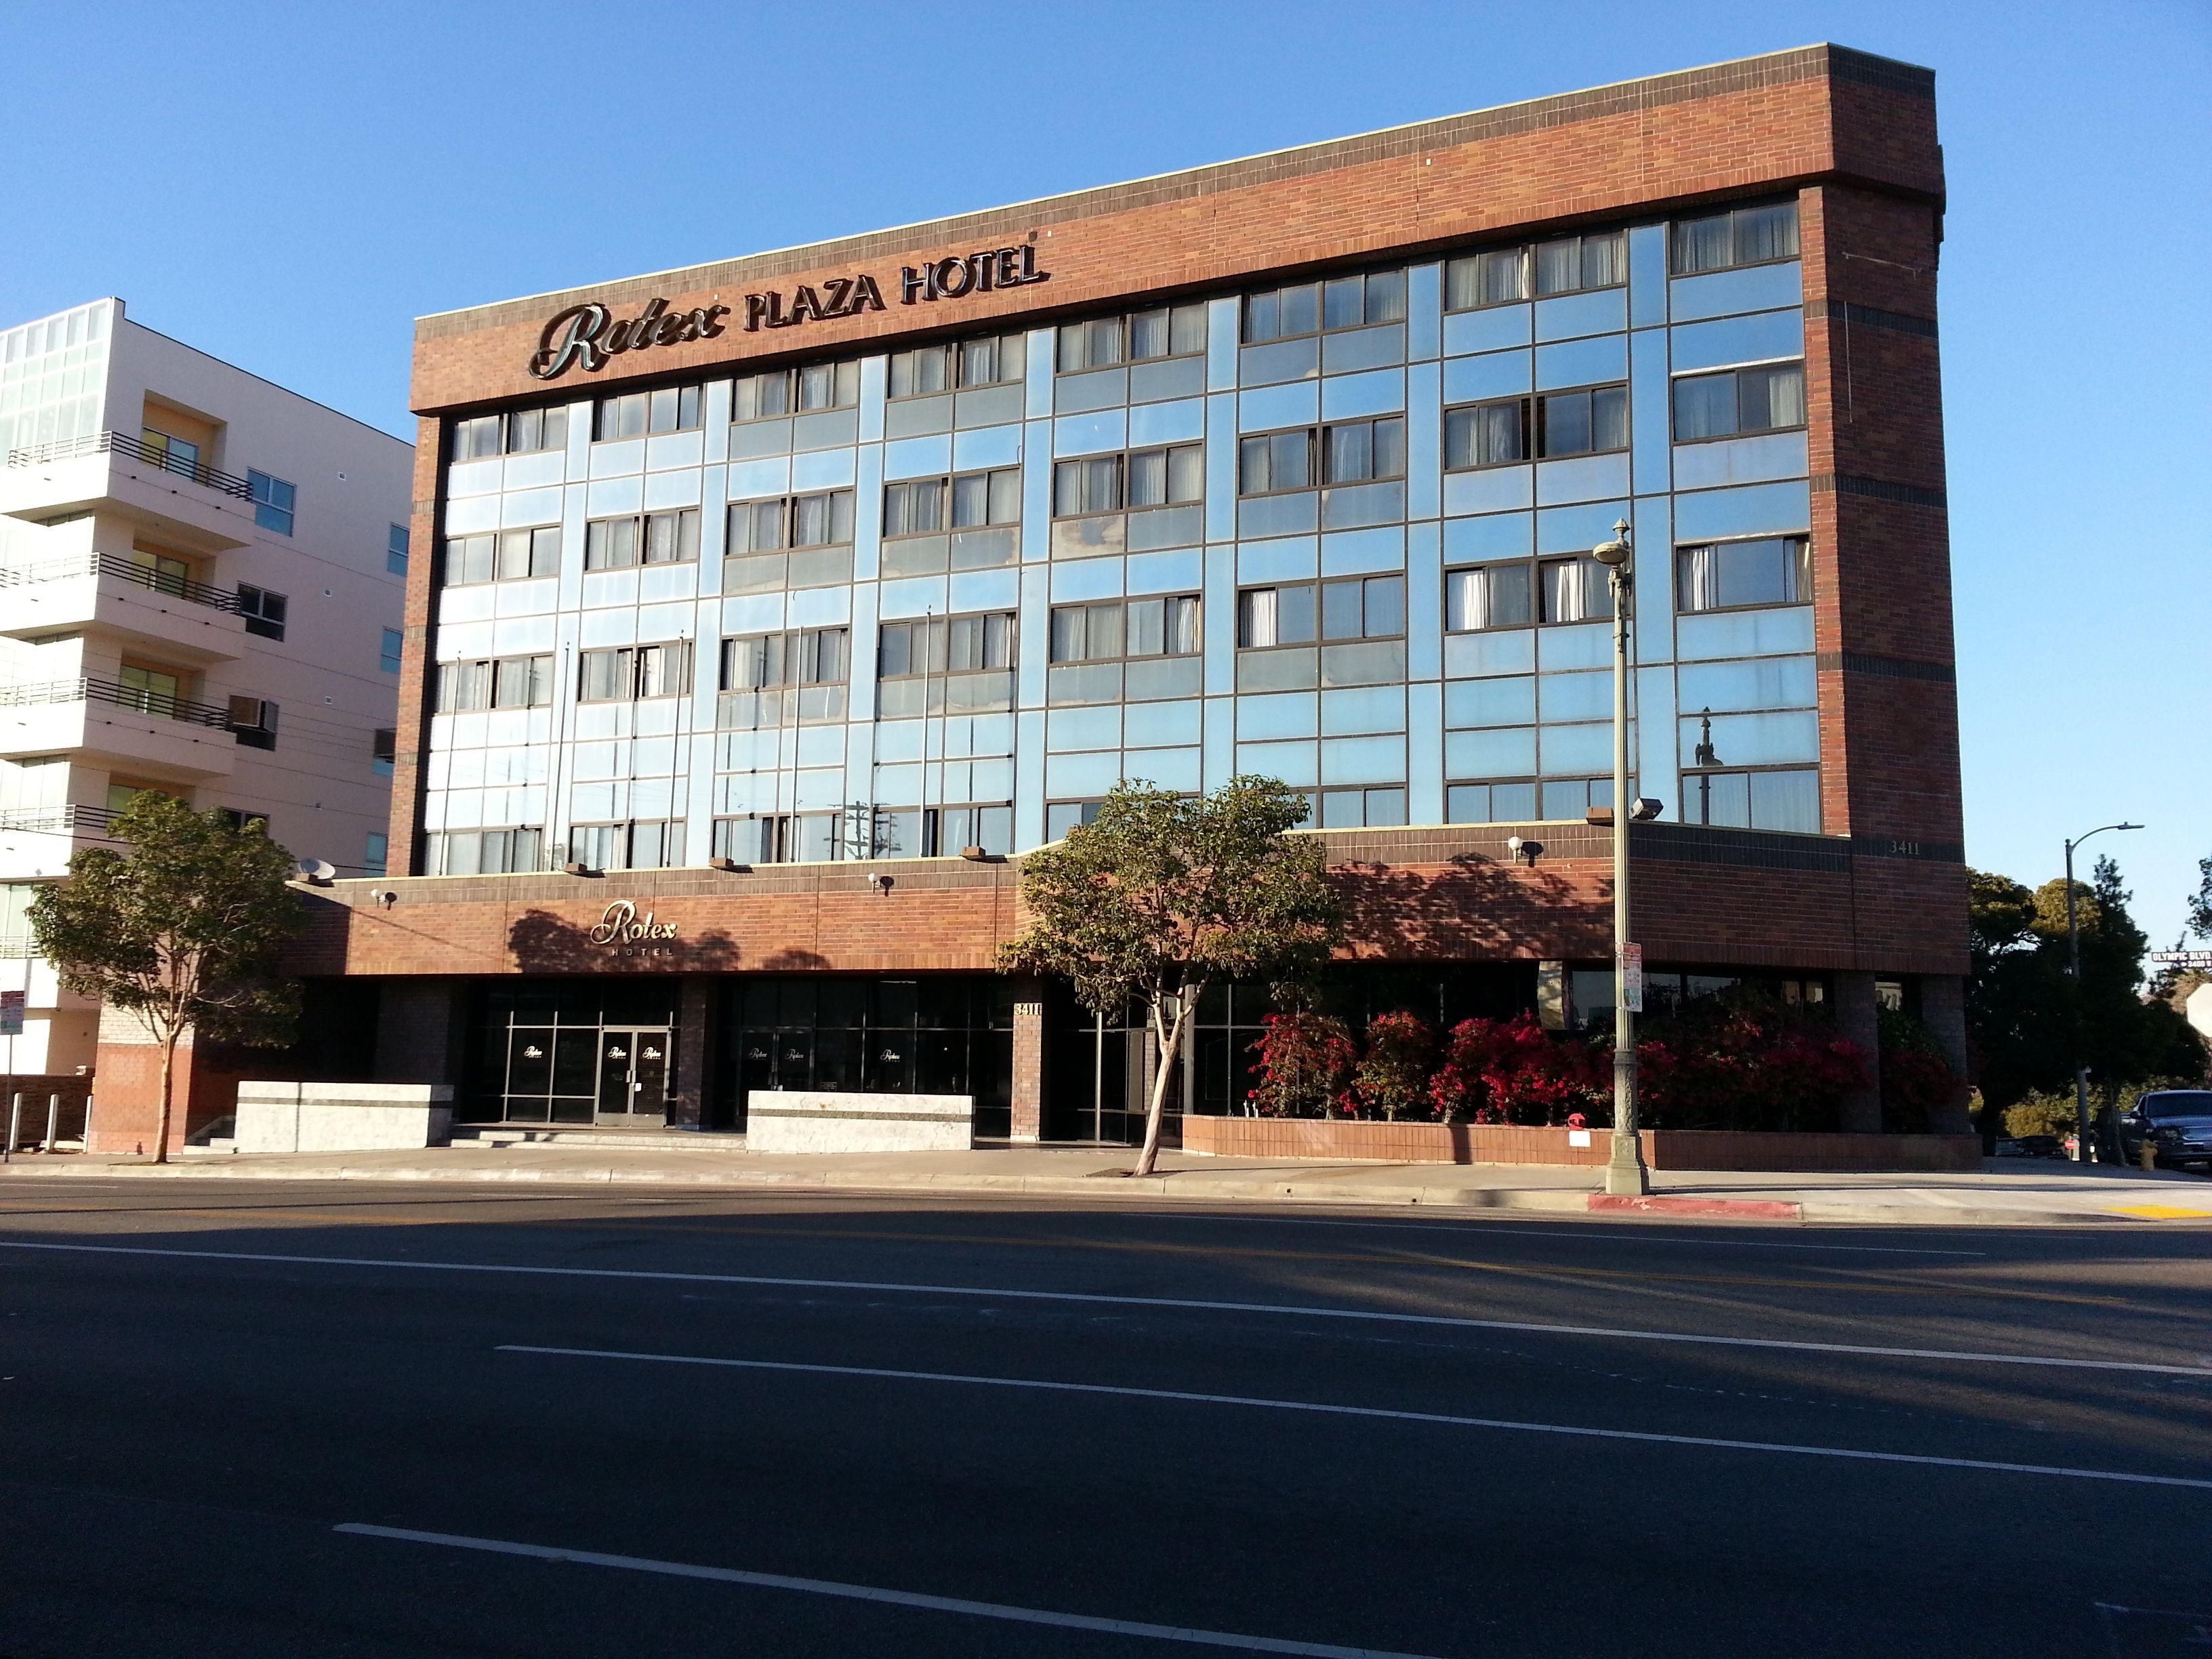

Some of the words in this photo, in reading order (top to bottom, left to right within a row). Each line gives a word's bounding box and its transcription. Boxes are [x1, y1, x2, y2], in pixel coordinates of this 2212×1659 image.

[529, 298, 731, 380] Rotex
[745, 274, 886, 332] PLAZA
[901, 245, 1050, 305] HOTEL
[1891, 840, 1919, 855] 3411
[590, 899, 678, 945] Rotex
[611, 948, 673, 956] HOTEL
[2152, 952, 2188, 961] OLYMPIC
[1015, 1003, 1040, 1015] 3411
